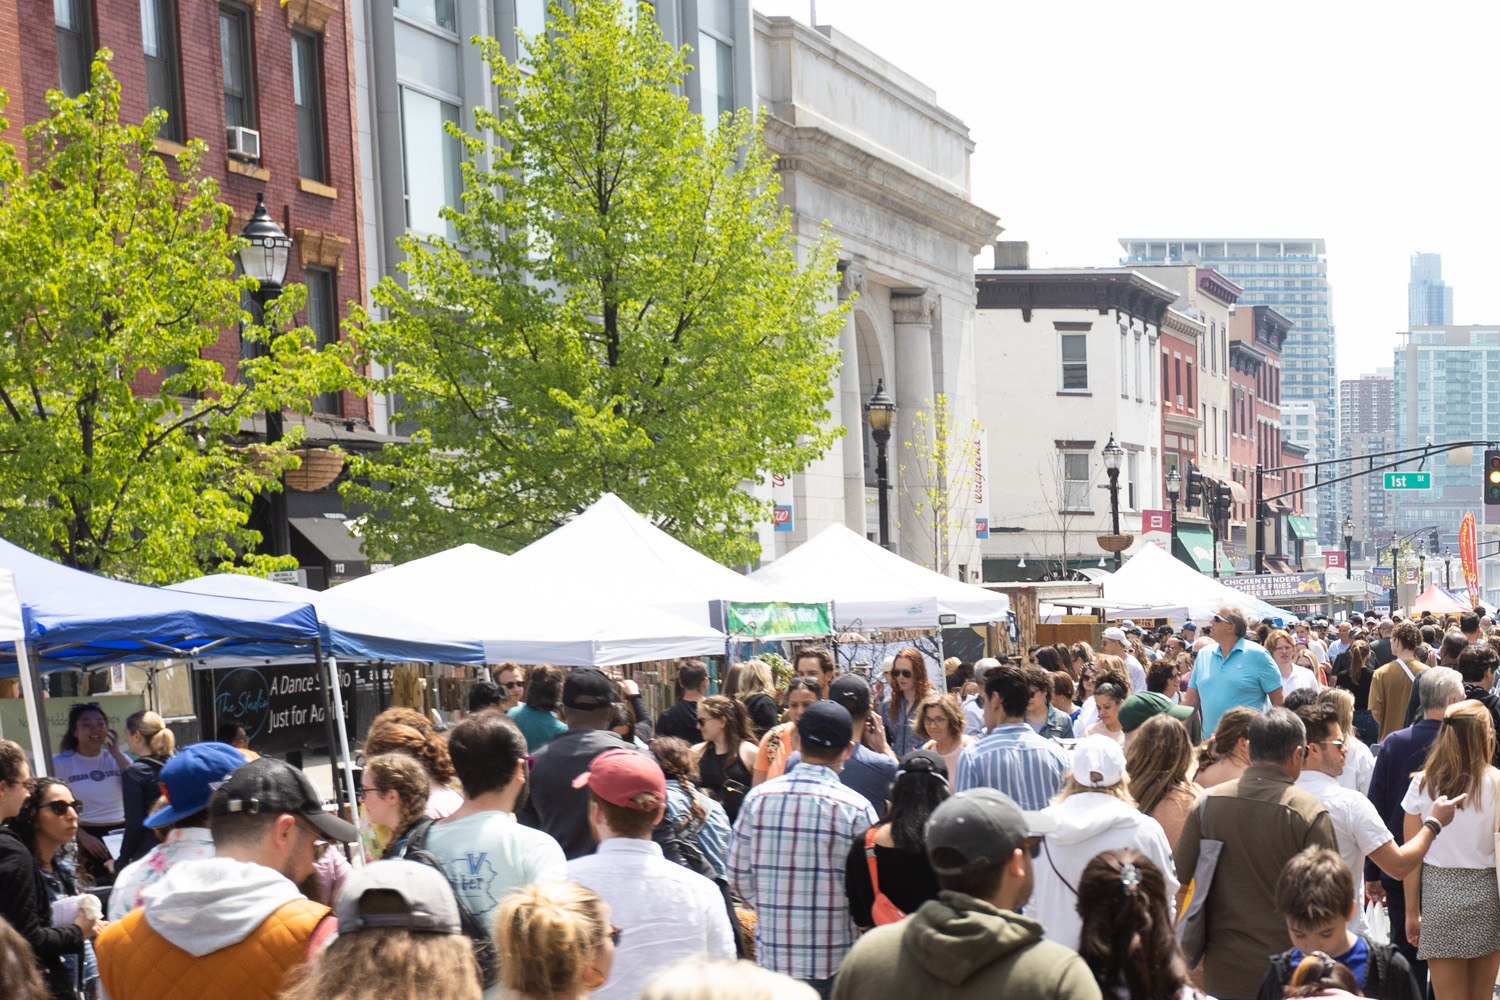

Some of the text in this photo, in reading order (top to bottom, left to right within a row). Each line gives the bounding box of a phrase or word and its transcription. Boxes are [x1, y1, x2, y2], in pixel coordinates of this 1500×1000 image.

[975, 439, 983, 505] Walgreens
[1391, 475, 1407, 488] 1st
[335, 564, 345, 574] 113
[1224, 576, 1302, 586] CHICKEN TENDERS
[1268, 582, 1292, 590] FRIES
[1262, 588, 1298, 596] BURGER
[270, 677, 278, 696] A
[280, 675, 314, 694] Dance
[216, 689, 270, 718] The Studio
[268, 708, 289, 734] Just
[291, 705, 306, 725] for
[68, 774, 90, 784] URBAN
